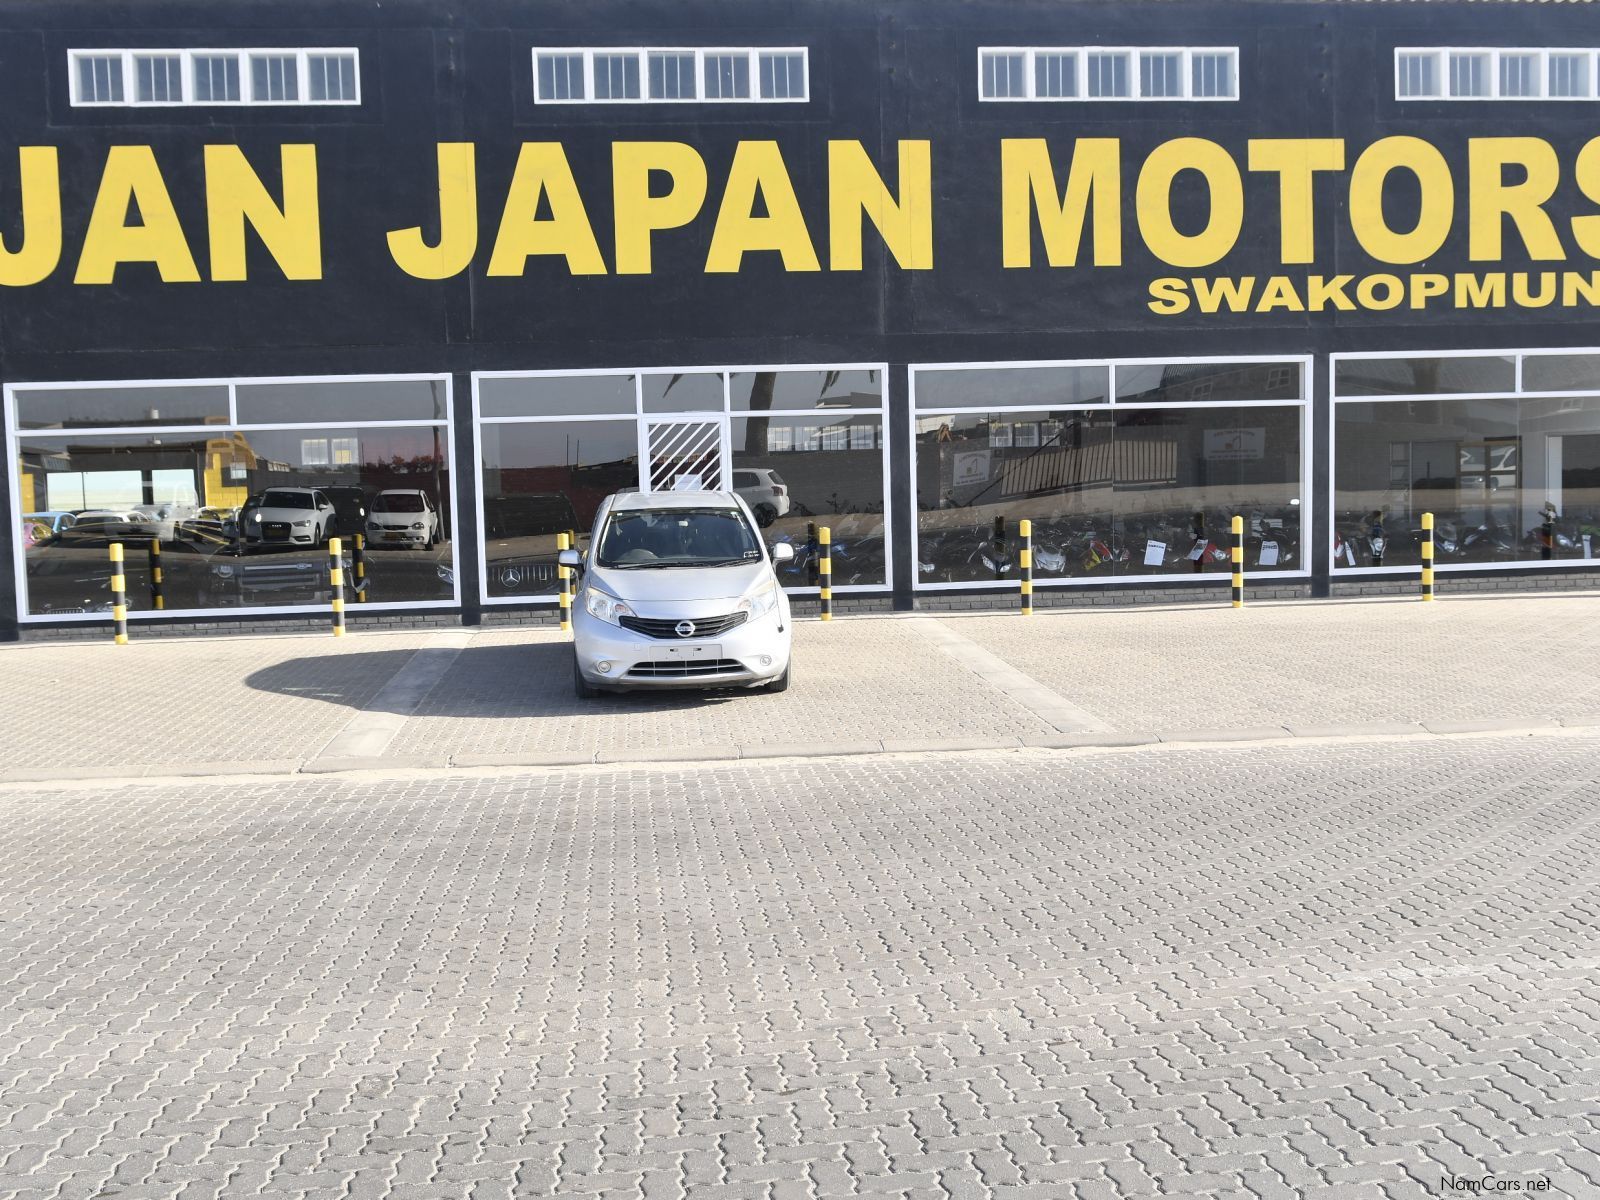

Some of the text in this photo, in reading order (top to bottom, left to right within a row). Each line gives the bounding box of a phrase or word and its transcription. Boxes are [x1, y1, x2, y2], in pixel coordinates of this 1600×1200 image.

[0, 143, 322, 286] JAN
[386, 139, 934, 280] JAPAN
[1148, 271, 1600, 315] SWAKOPMUN
